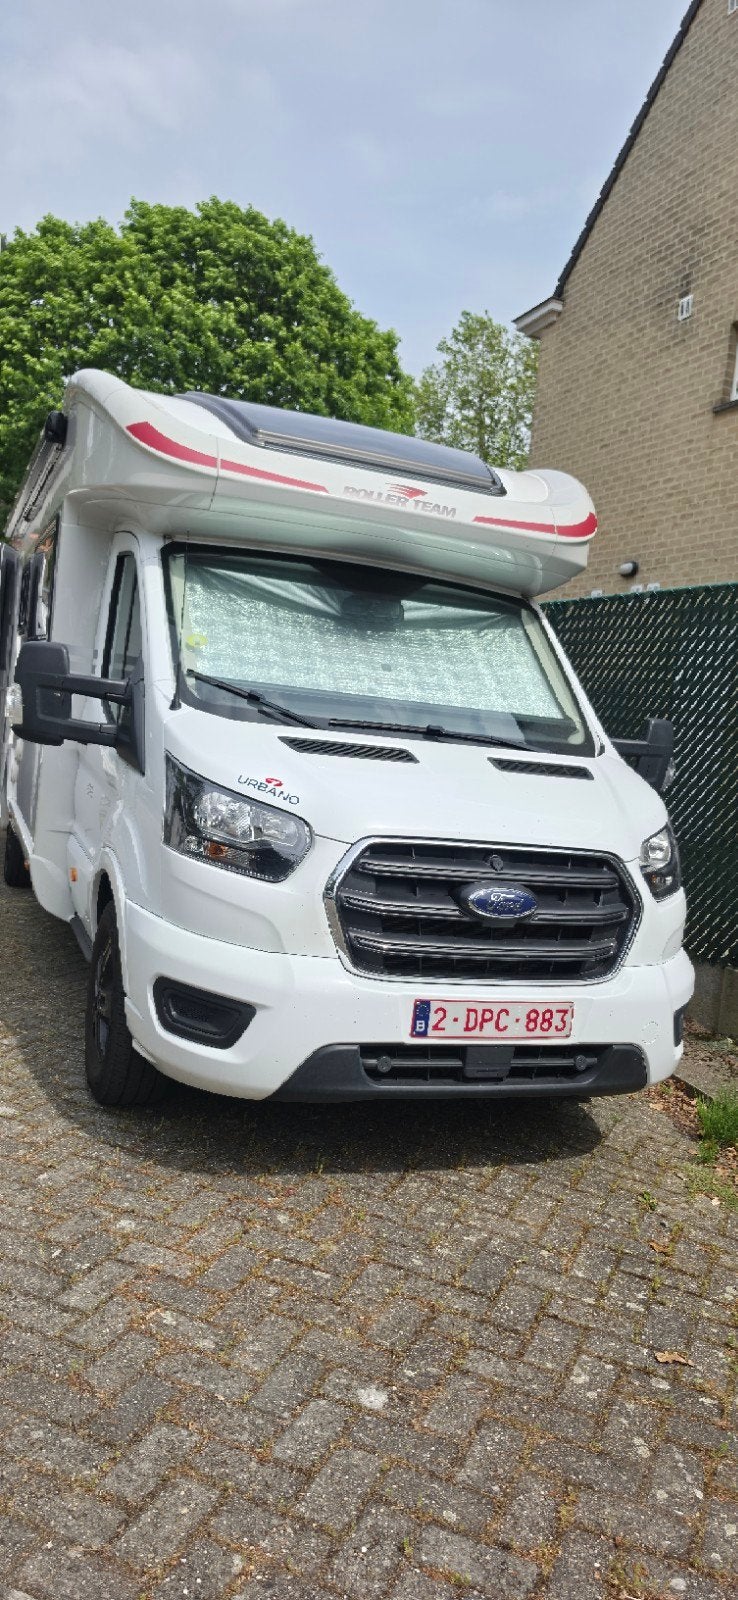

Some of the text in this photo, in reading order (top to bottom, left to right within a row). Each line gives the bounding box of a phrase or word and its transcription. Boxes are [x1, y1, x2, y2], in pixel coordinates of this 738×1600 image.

[343, 486, 457, 519] ROLLER TEAM
[237, 774, 300, 805] URBANO
[486, 892, 524, 910] Ford
[415, 1020, 426, 1032] B
